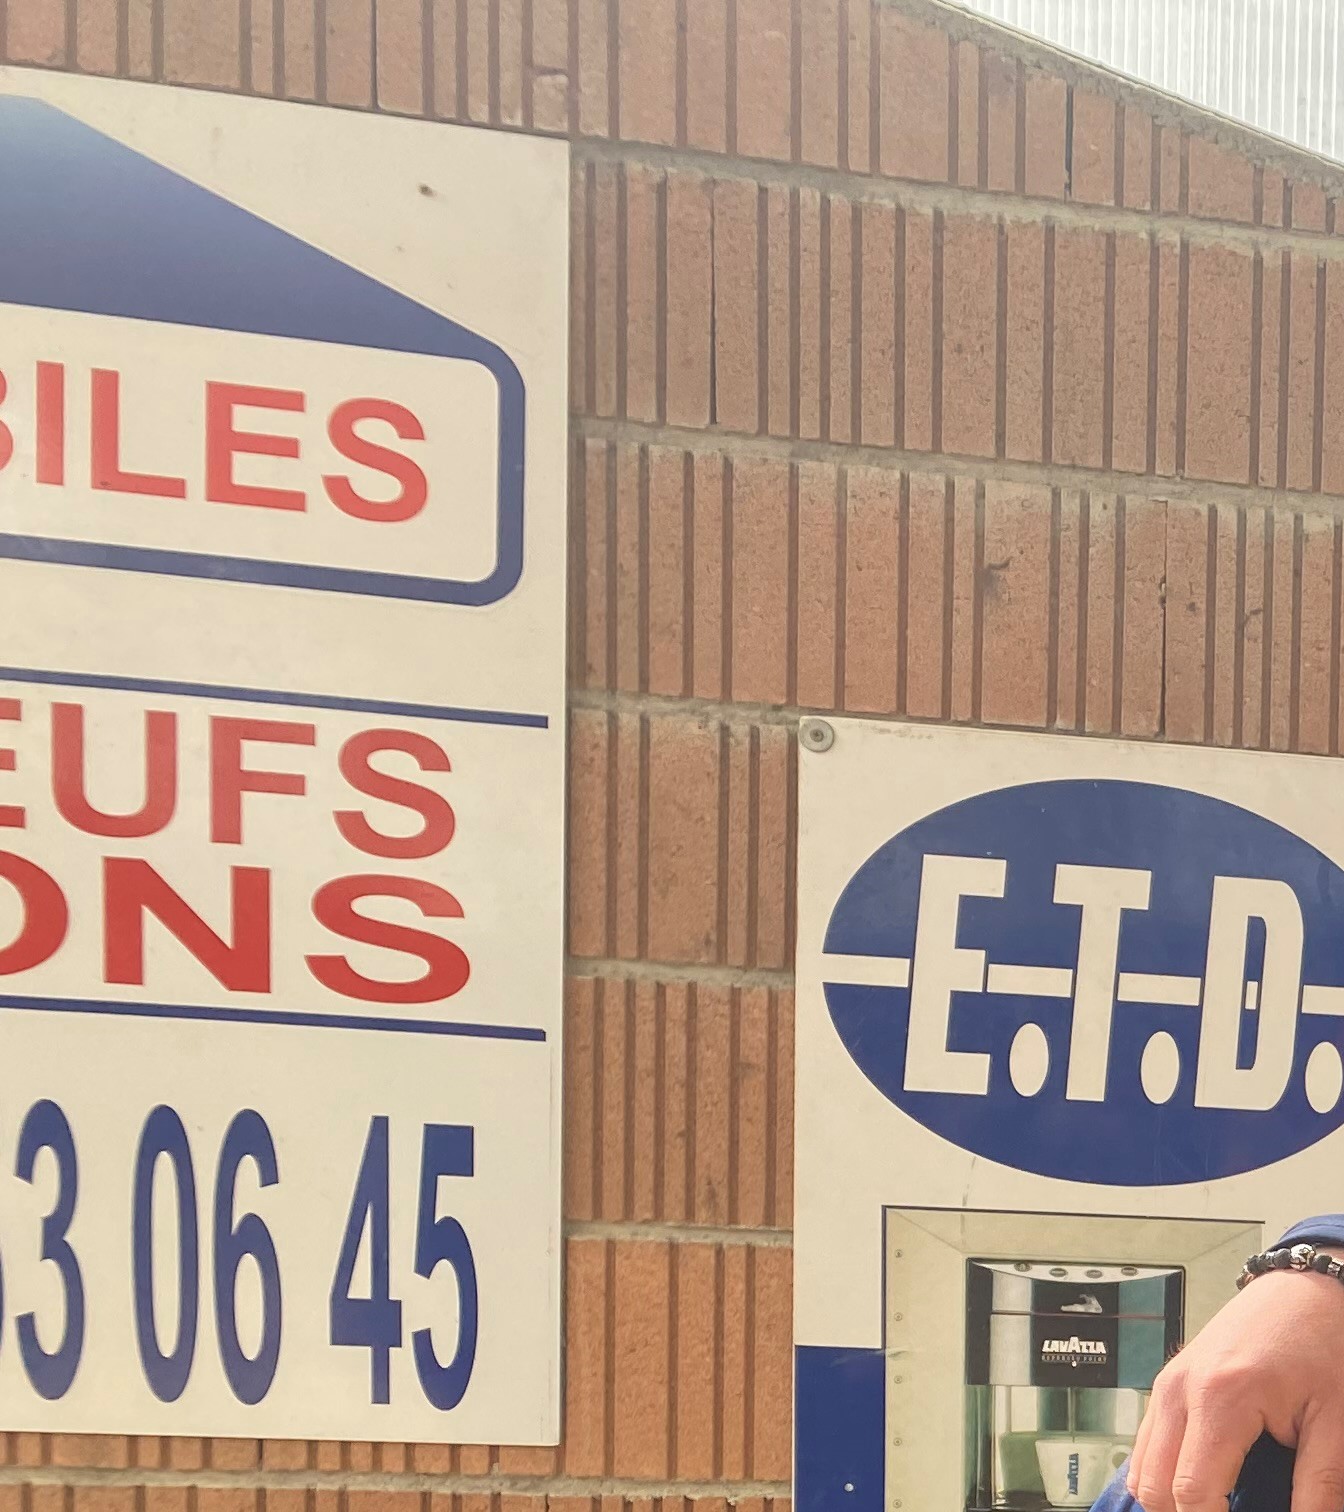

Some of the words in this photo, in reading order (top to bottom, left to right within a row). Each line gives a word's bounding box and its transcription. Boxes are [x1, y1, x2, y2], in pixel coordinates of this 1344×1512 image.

[0, 358, 429, 524] ILES
[0, 698, 457, 861] UFS
[0, 1098, 85, 1401] 3
[131, 1102, 282, 1405] 06
[328, 1113, 479, 1412] 45
[1042, 1336, 1107, 1354] LAVAZZA
